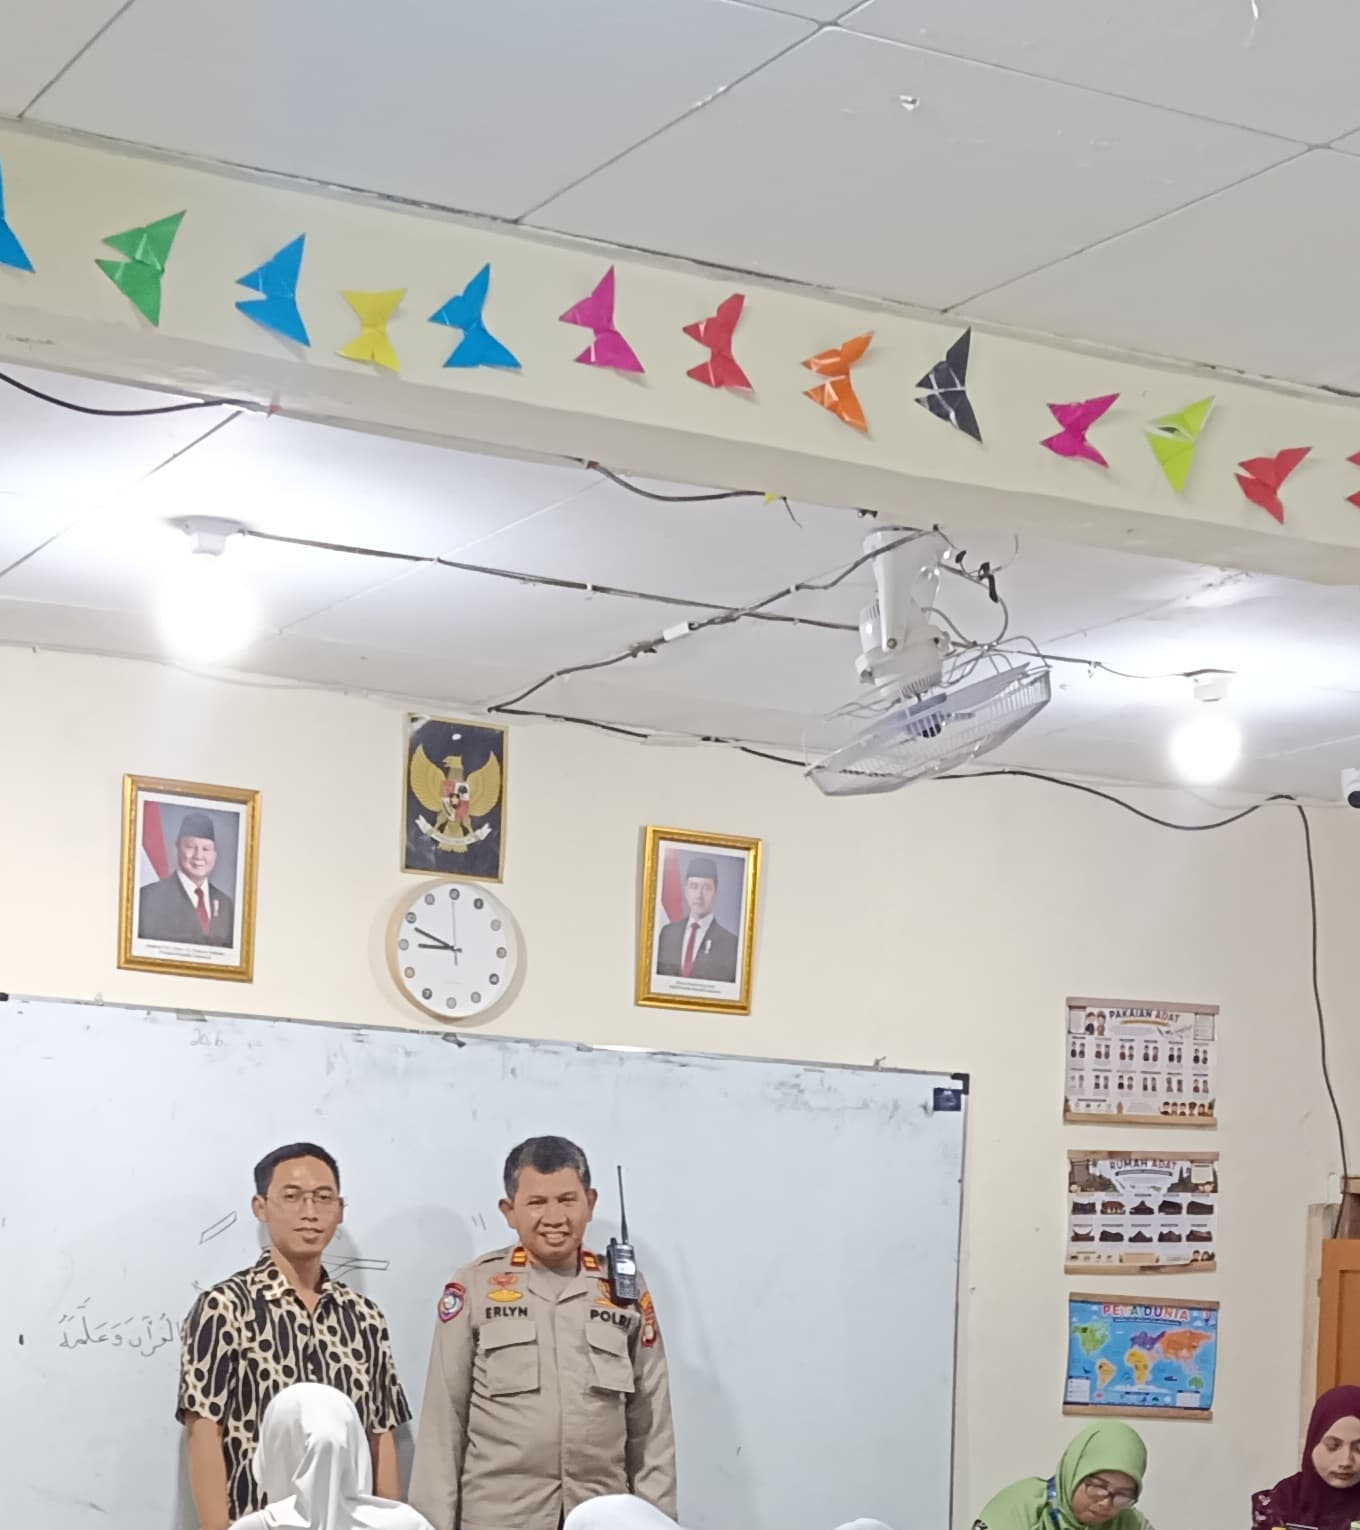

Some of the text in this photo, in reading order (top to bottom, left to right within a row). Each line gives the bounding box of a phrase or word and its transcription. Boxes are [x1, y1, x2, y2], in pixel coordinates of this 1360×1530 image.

[1109, 1008, 1153, 1019] PAKAIAN
[485, 1306, 529, 1319] ERLYN
[1103, 1303, 1189, 1320] PETA DUNIA
